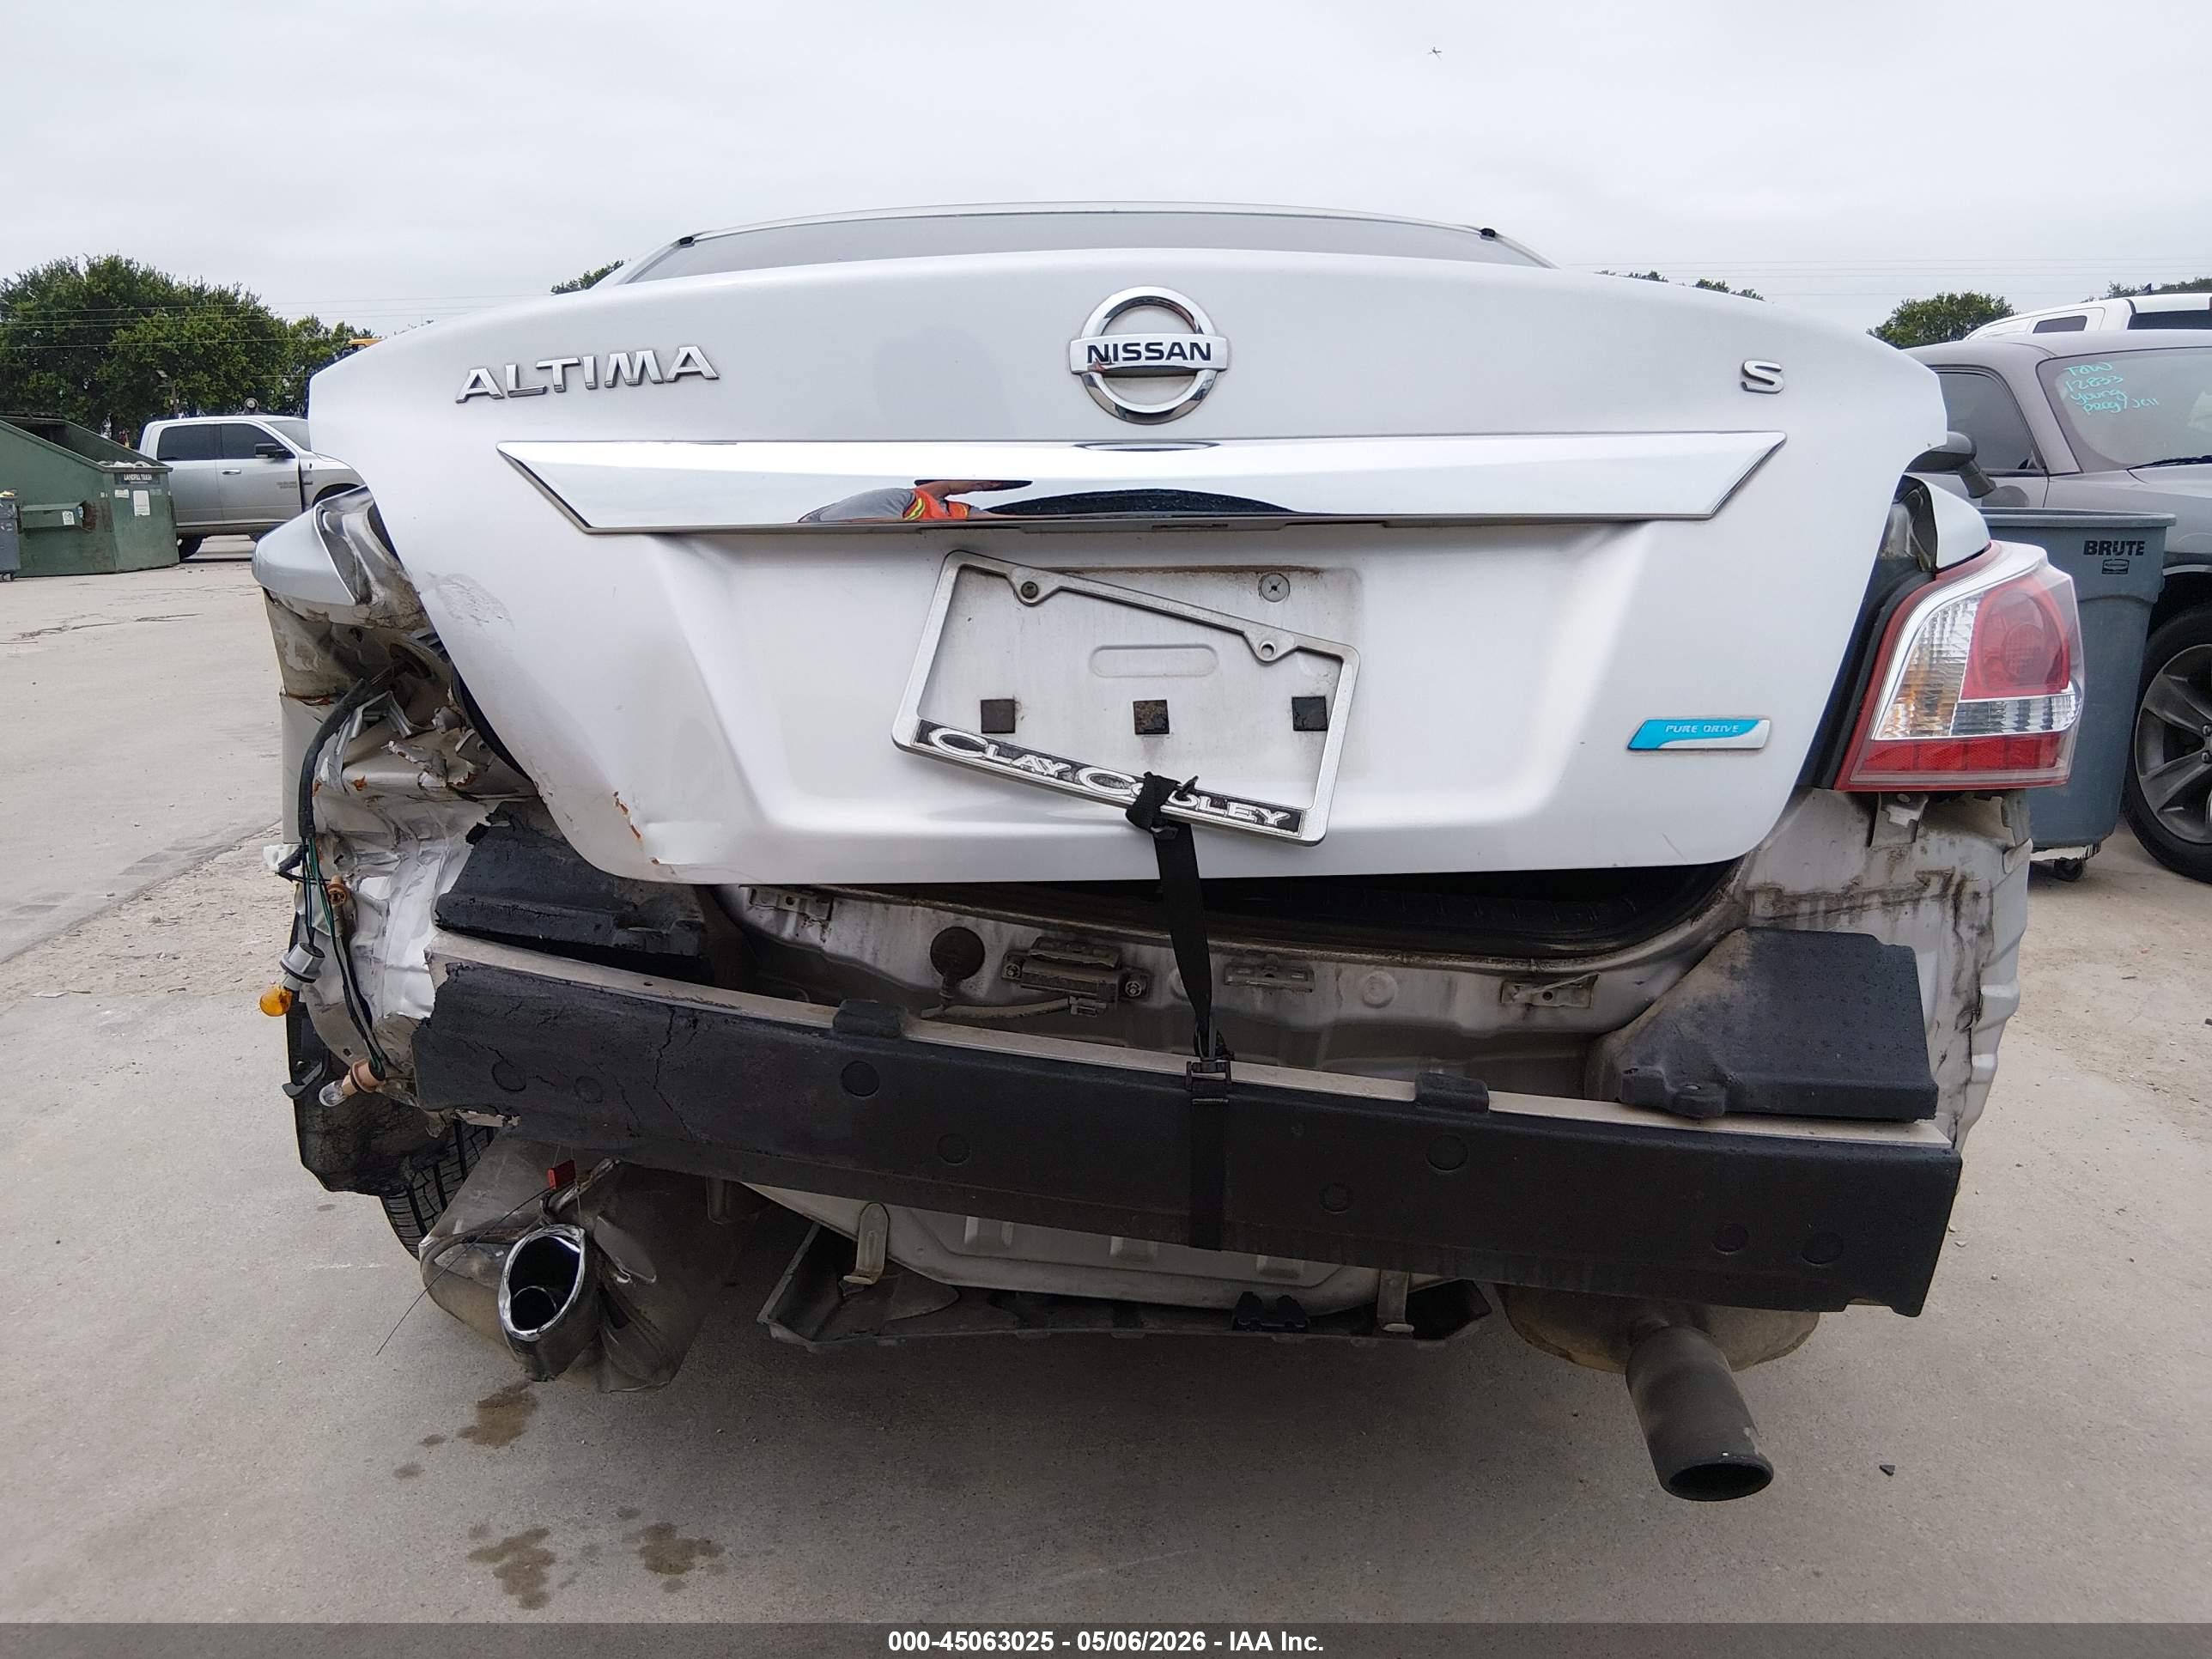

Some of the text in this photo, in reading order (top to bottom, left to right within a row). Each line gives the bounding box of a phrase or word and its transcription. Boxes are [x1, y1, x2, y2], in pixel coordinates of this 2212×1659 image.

[1087, 342, 1212, 364] NISSAN
[455, 345, 720, 404] ALTIMA
[1741, 360, 1784, 394] S
[2083, 540, 2145, 556] BRUTE
[928, 727, 1072, 777] CLAY
